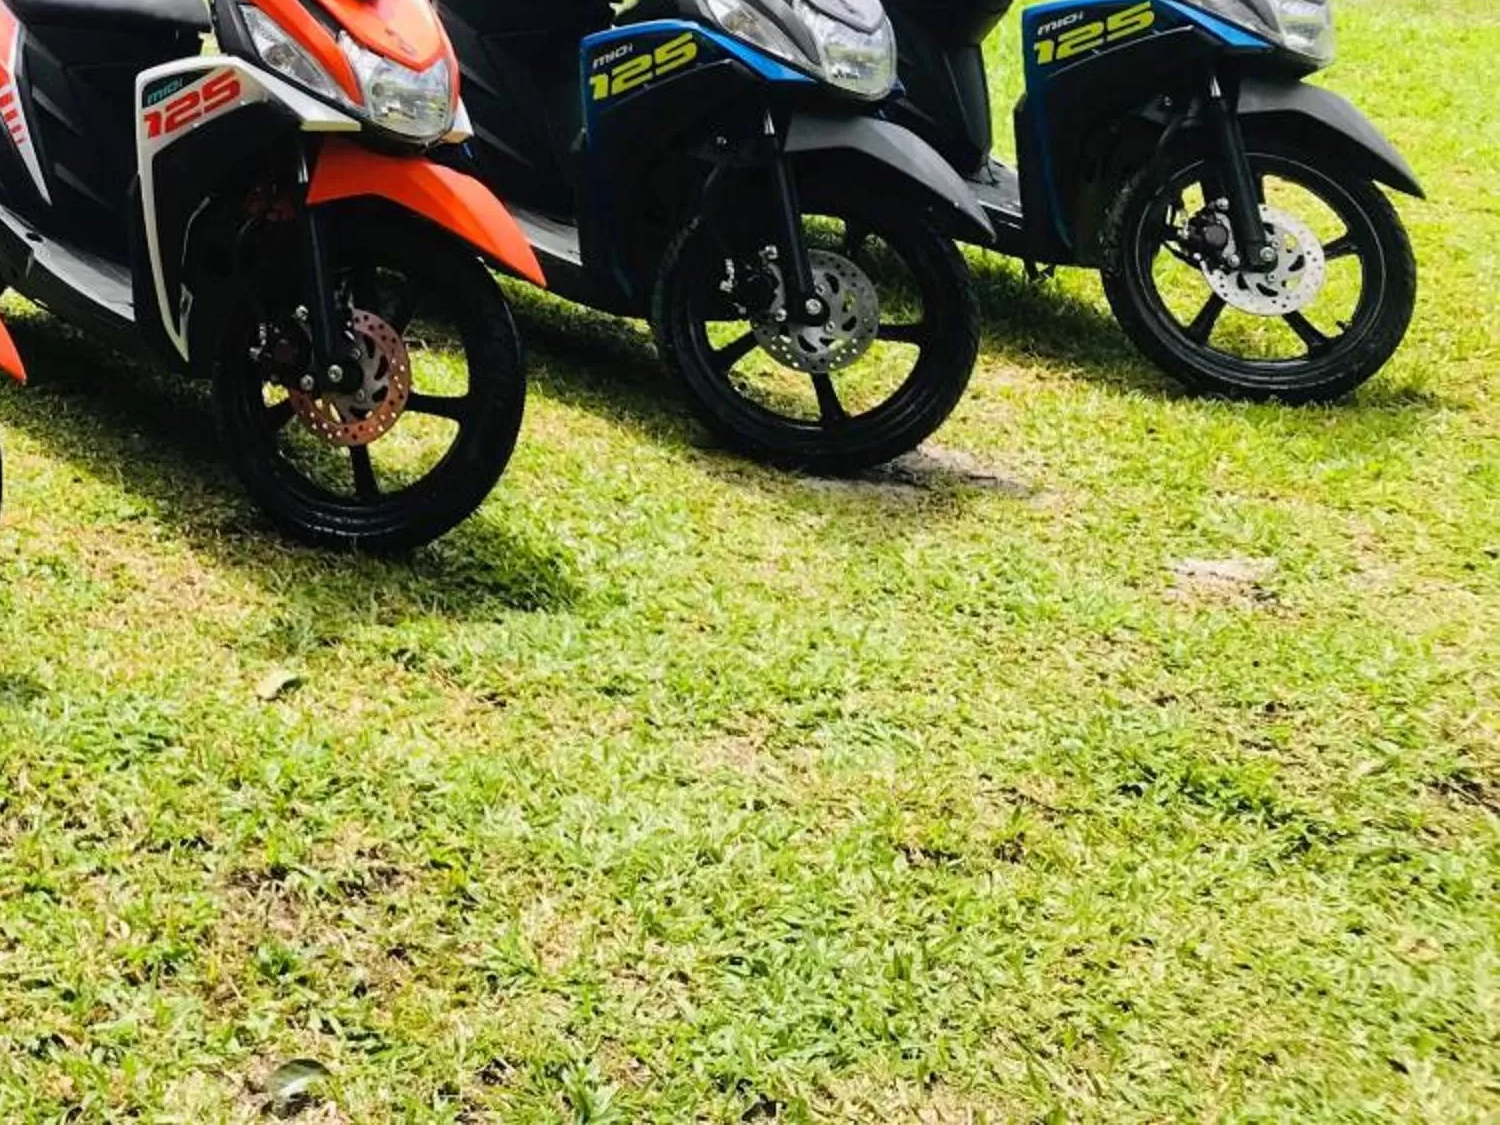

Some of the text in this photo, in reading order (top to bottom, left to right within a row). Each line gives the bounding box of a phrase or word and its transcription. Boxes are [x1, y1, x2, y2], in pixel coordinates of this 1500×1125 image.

[589, 31, 697, 101] 125
[1033, 0, 1155, 65] 125
[143, 67, 241, 140] 125
